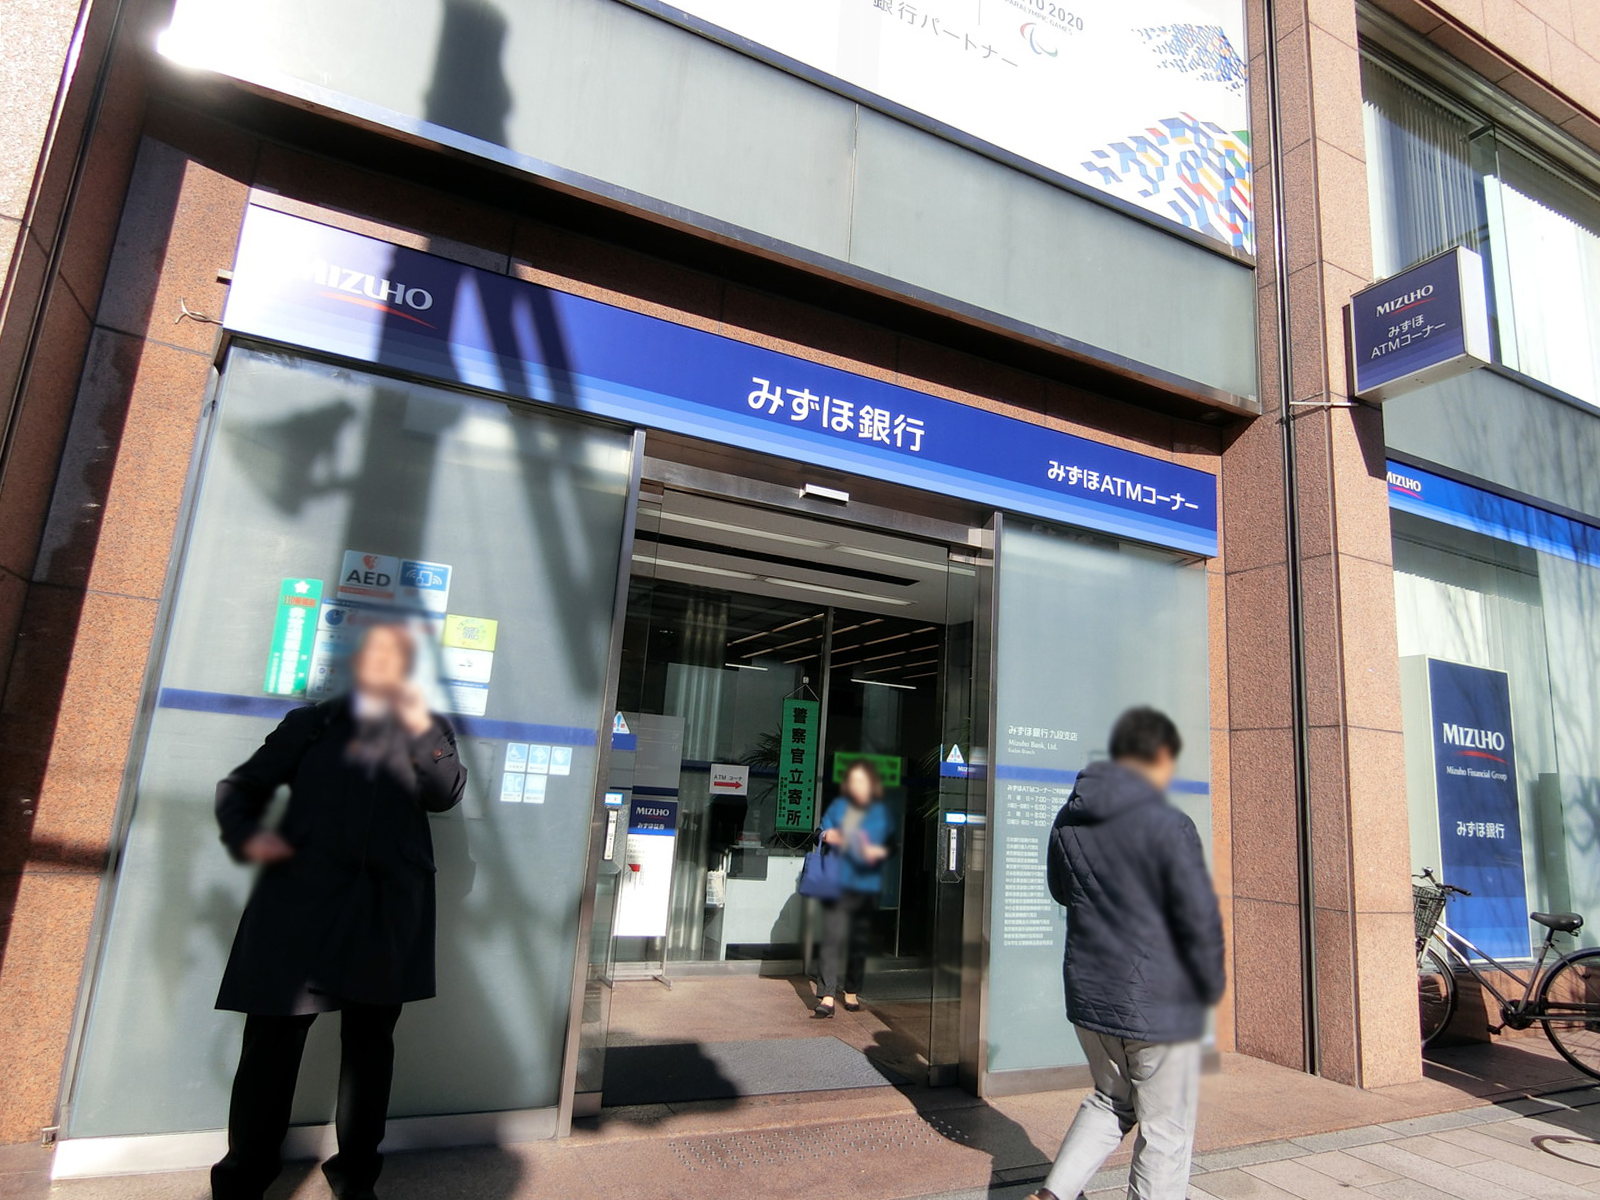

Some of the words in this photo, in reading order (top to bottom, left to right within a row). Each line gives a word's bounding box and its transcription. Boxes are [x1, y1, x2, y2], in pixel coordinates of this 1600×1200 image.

[1049, 3, 1083, 31] 2020
[1049, 19, 1073, 35] GAMES
[1376, 284, 1434, 318] MIZUHO
[1388, 314, 1424, 338] みずほ
[1371, 323, 1446, 359] ATMコーナー
[748, 376, 926, 452] みずほ銀行
[1046, 459, 1200, 512] みずほATMコーナー
[345, 569, 391, 587] AED
[1008, 725, 1048, 738] みずほ銀行
[1008, 739, 1029, 747] Mizuho
[1442, 722, 1506, 751] MIZUHO
[786, 707, 808, 826] 警察官立寄所
[1446, 766, 1467, 776] Mizuho
[1467, 767, 1491, 779] Financial
[1491, 770, 1508, 783] Group
[635, 807, 670, 817] MIZUHO
[1456, 821, 1506, 839] みずほ銀行
